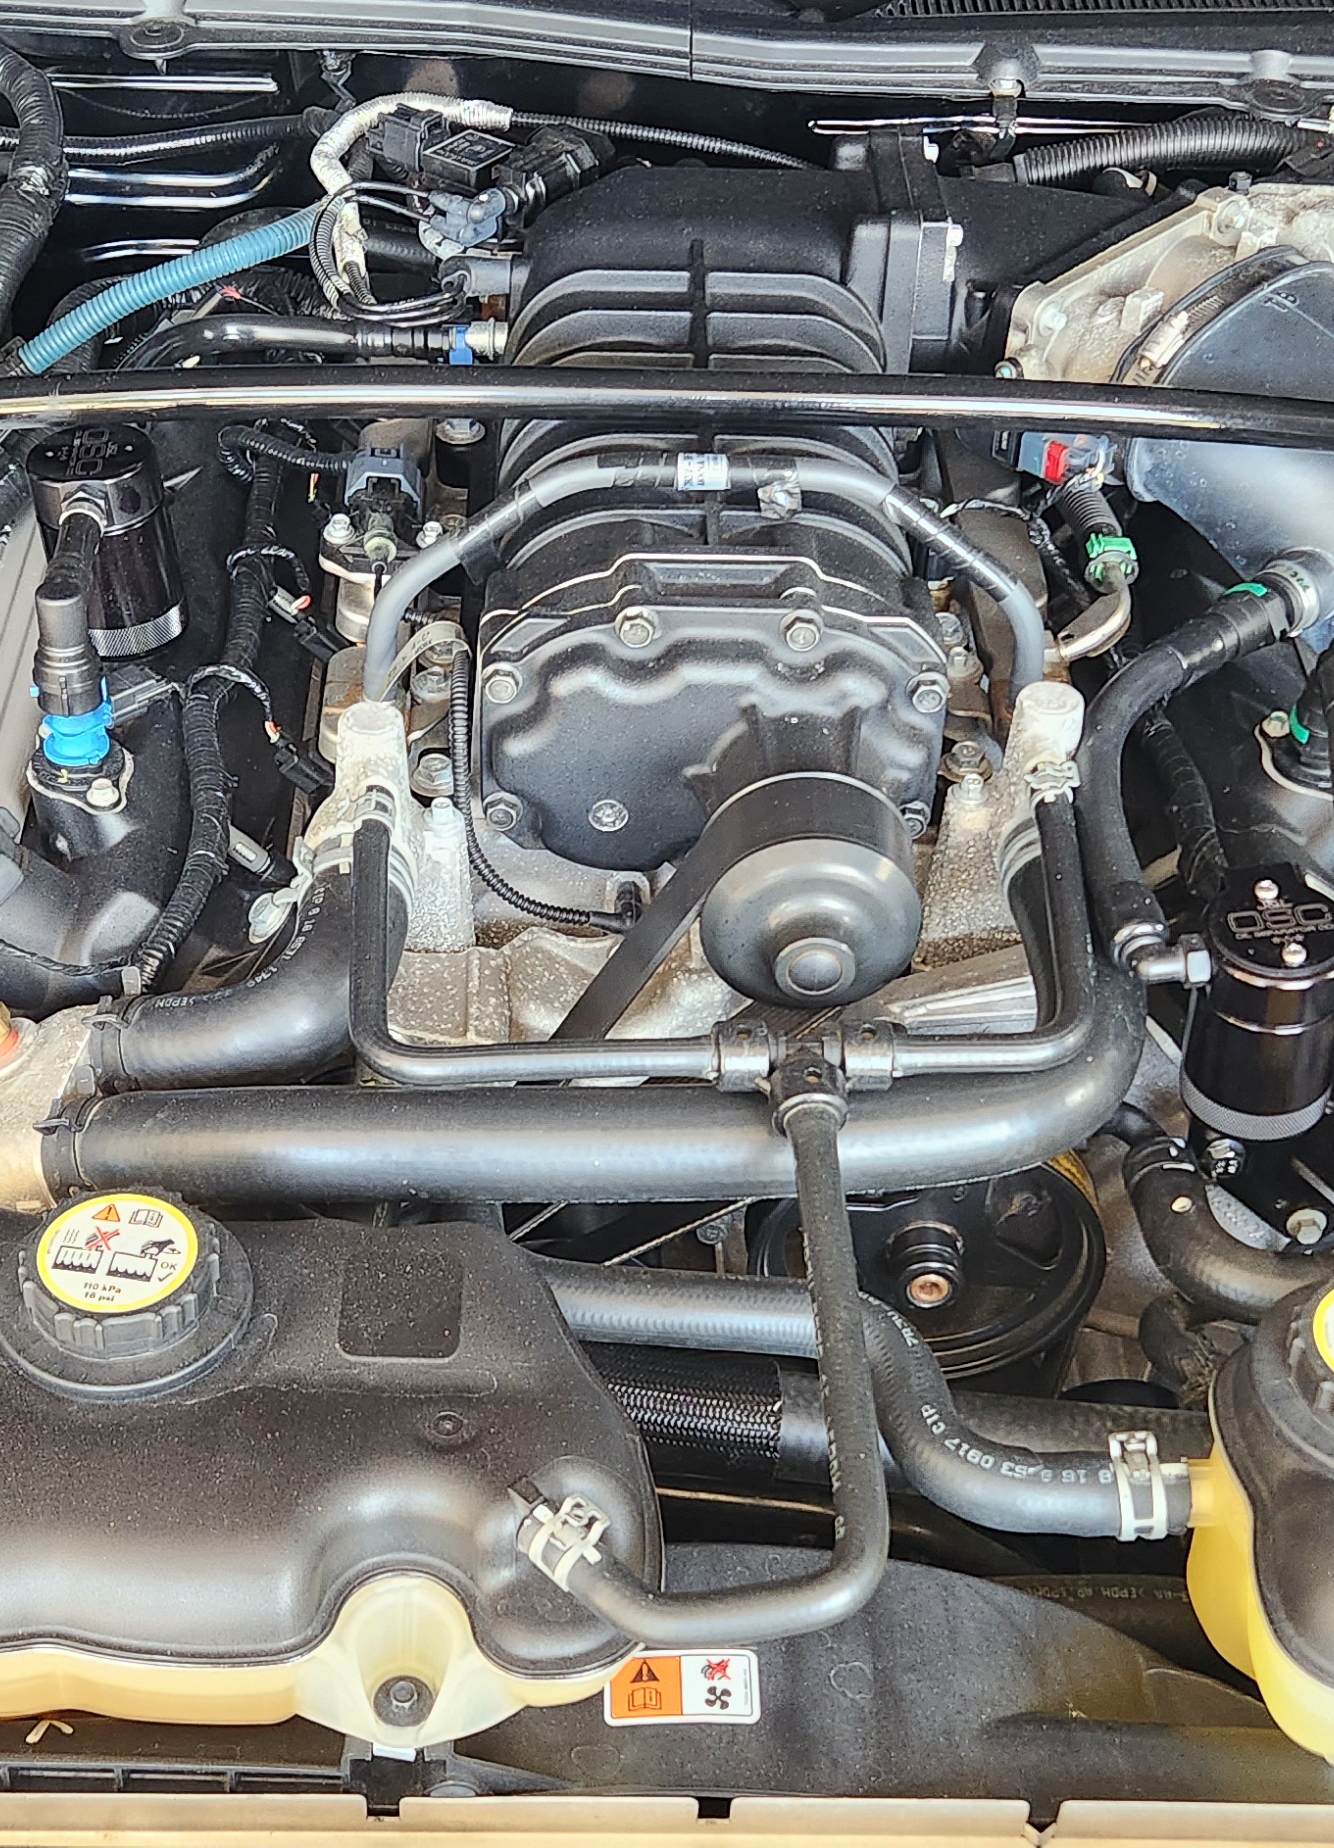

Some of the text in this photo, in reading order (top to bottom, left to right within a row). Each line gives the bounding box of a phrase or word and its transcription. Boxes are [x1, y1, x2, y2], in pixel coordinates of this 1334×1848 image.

[1227, 902, 1333, 933] OSC
[160, 1261, 178, 1271] OK
[83, 1281, 122, 1294] 110 kPa
[98, 1294, 115, 1302] psi
